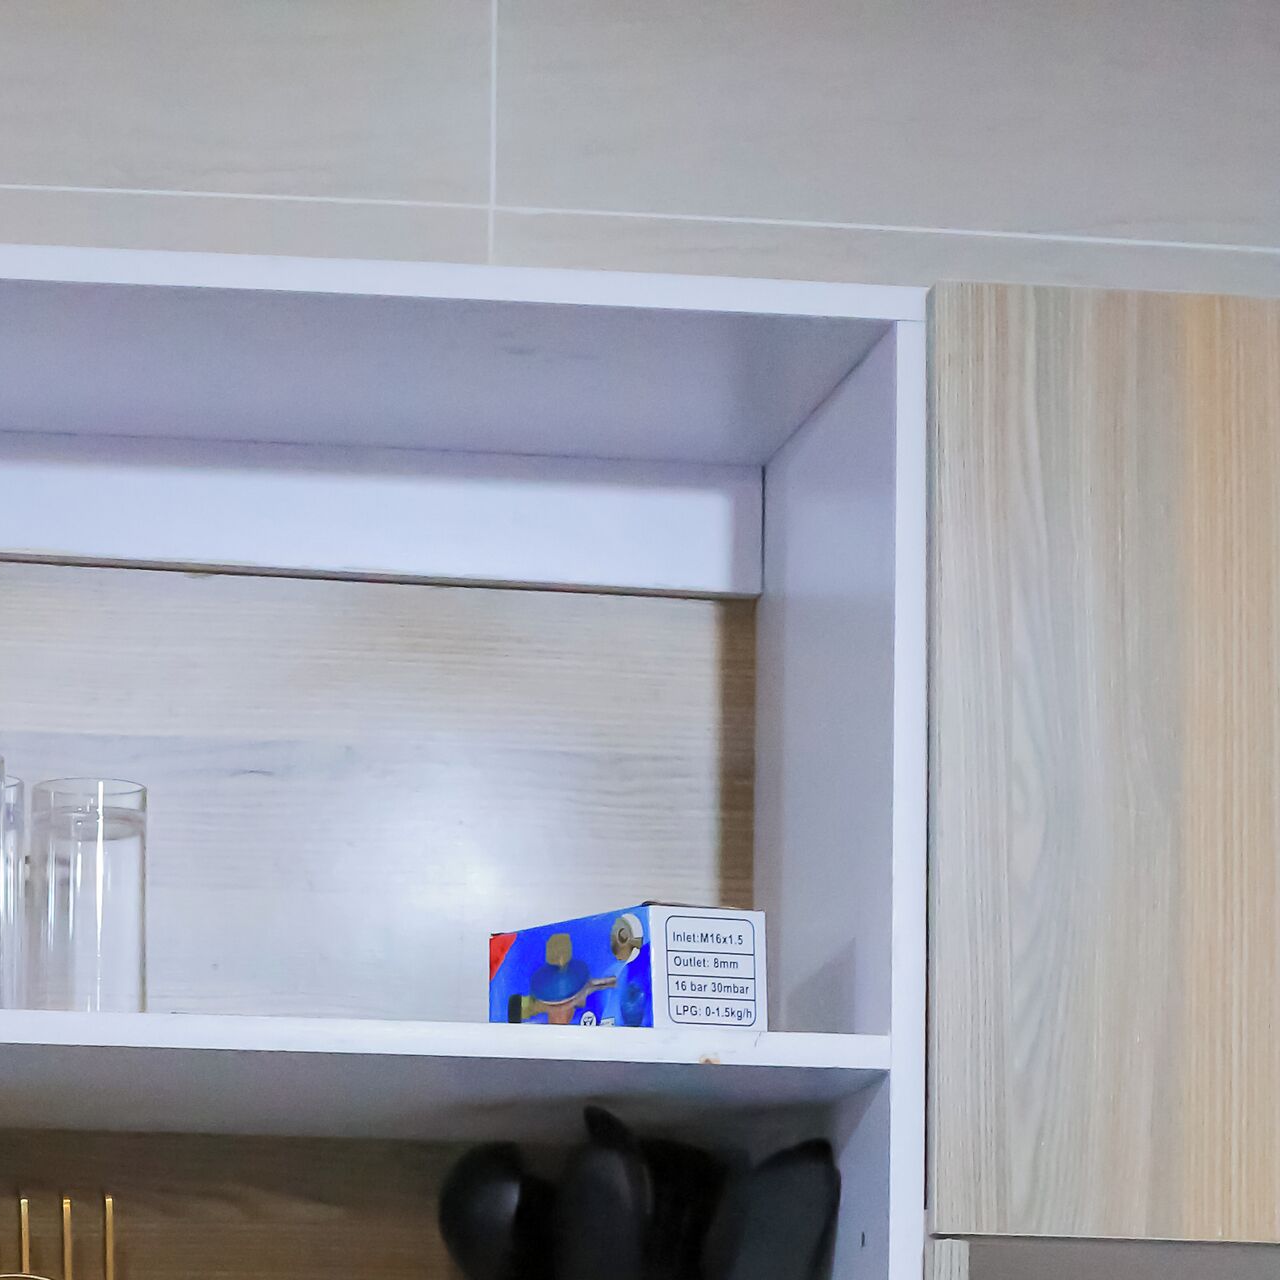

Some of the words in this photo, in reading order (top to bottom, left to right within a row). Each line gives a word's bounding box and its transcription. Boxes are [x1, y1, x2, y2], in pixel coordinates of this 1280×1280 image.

[672, 931, 744, 946] Inlet:M16x1.5
[673, 956, 710, 968] Outlet:
[713, 958, 739, 969] 8mm
[675, 980, 687, 992] 16
[690, 981, 708, 992] bar
[711, 982, 750, 995] 30mbar
[676, 1005, 702, 1016] LPG:
[705, 1006, 753, 1021] 0-1.5kg/h
